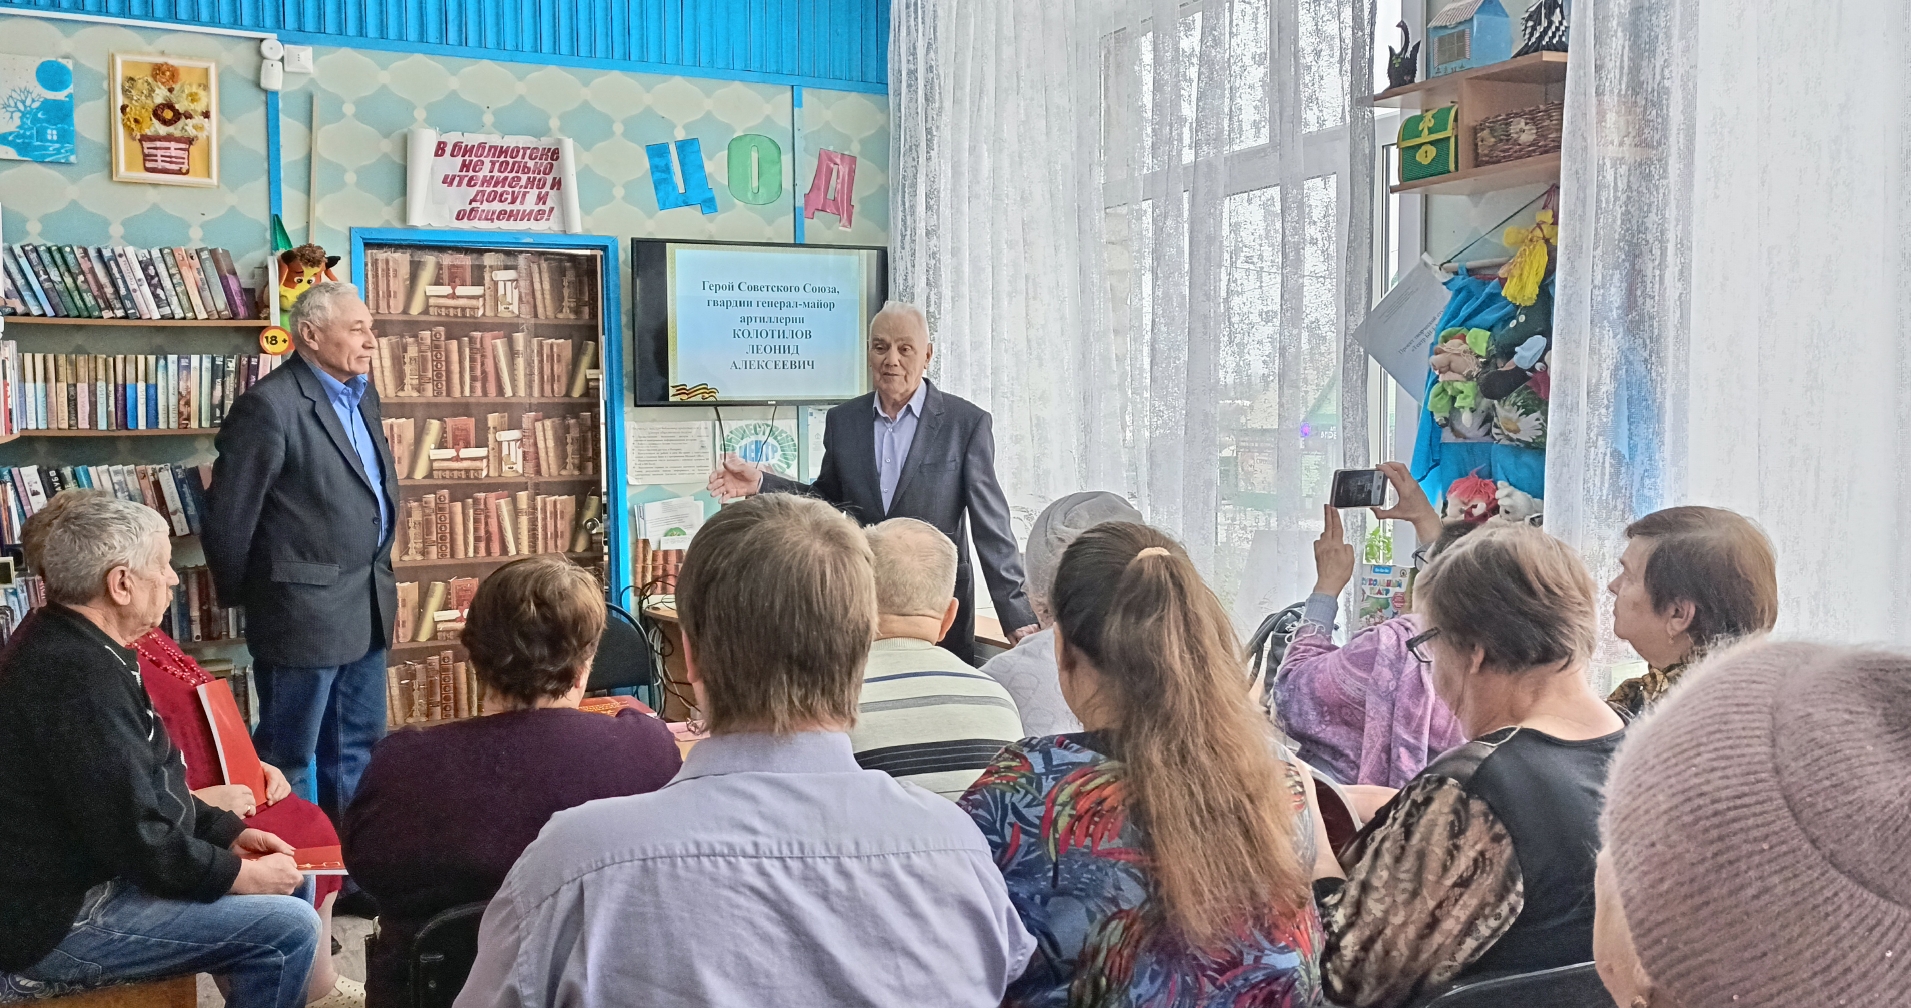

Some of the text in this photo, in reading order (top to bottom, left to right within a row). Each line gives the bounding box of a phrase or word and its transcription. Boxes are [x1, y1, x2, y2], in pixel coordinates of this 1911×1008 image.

[434, 140, 560, 161] В библиотеке
[458, 159, 554, 176] не только
[549, 176, 562, 191] и
[646, 134, 857, 230] ЦОД
[468, 190, 549, 205] досуг и
[455, 206, 555, 223] общение!
[701, 281, 840, 295] Герой Советского Союза,
[707, 299, 836, 311] гвардии генерал-майор
[739, 315, 805, 326] артиллерии
[732, 328, 812, 340] КОЛОТИЛОВ
[745, 345, 800, 356] ЛЕОНИД
[729, 360, 815, 370] АЛЕКСЕЕВИЧ
[739, 439, 779, 463] ЦЕНТР
